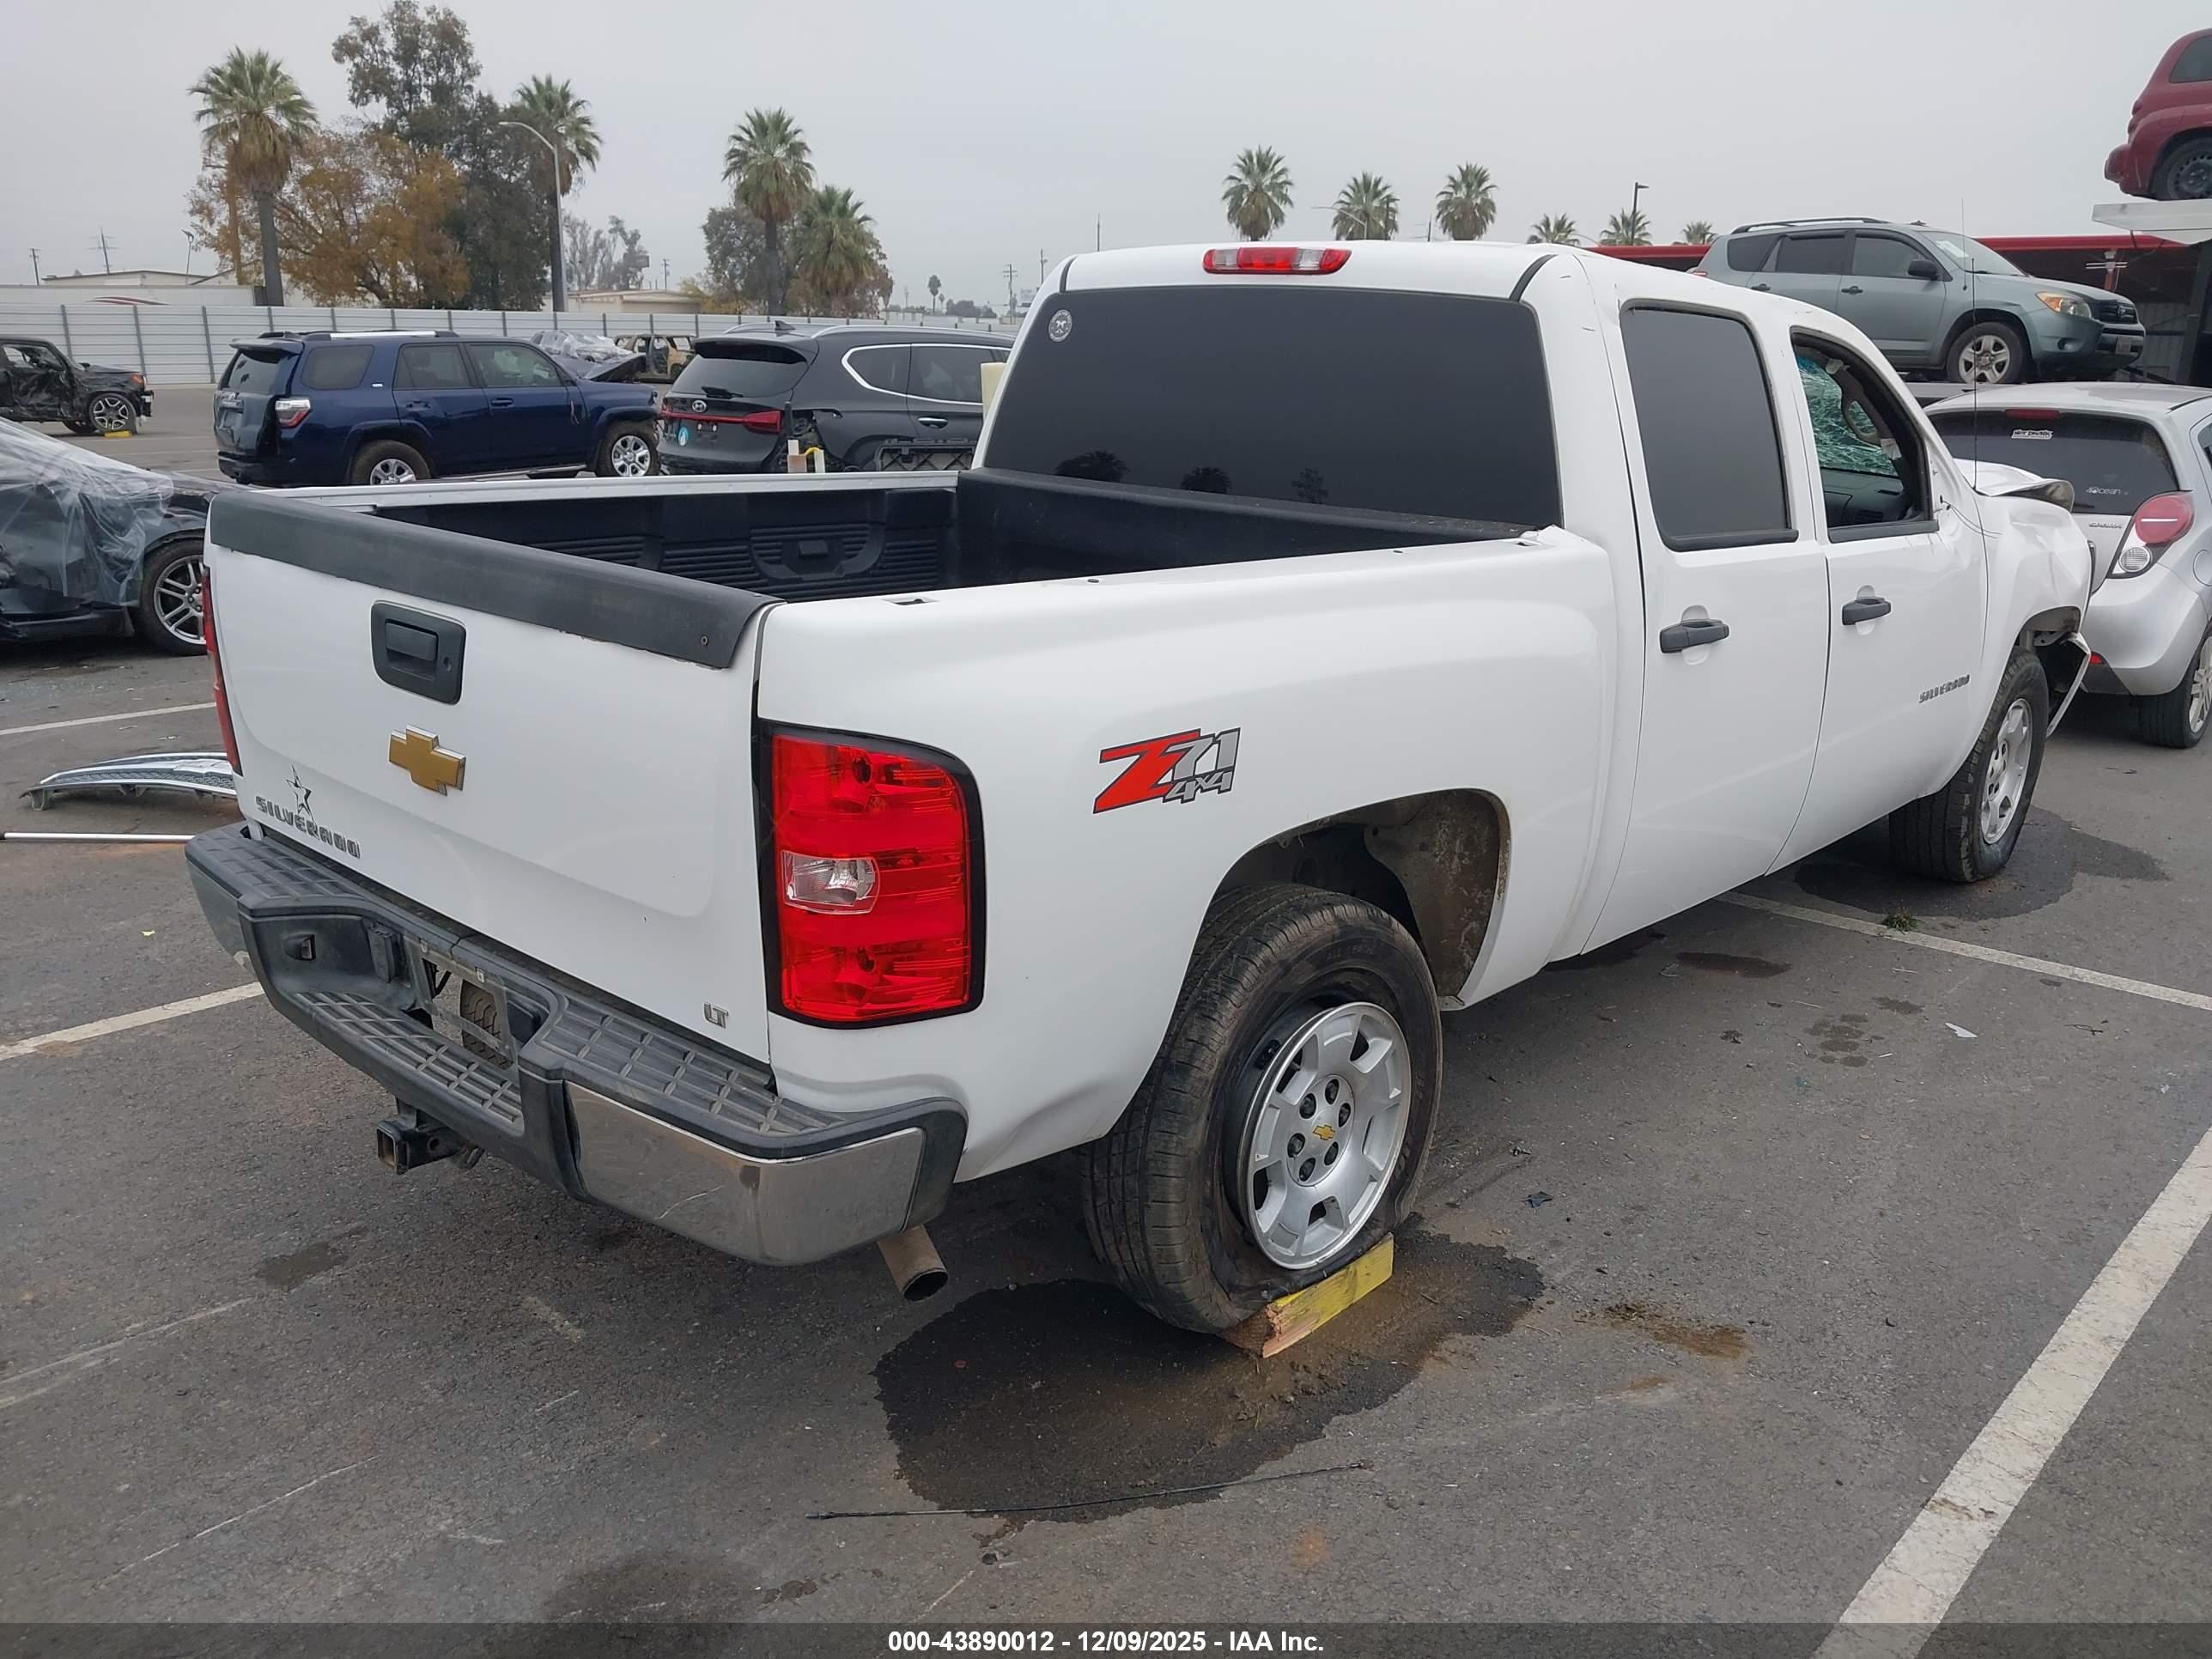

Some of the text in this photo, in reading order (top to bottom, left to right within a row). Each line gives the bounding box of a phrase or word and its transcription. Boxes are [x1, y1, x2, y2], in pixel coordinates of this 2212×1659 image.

[1918, 673, 1970, 703] SILVERADO
[1093, 727, 1241, 813] Z71
[255, 795, 361, 859] SILVERADO
[703, 1002, 728, 1029] LT
